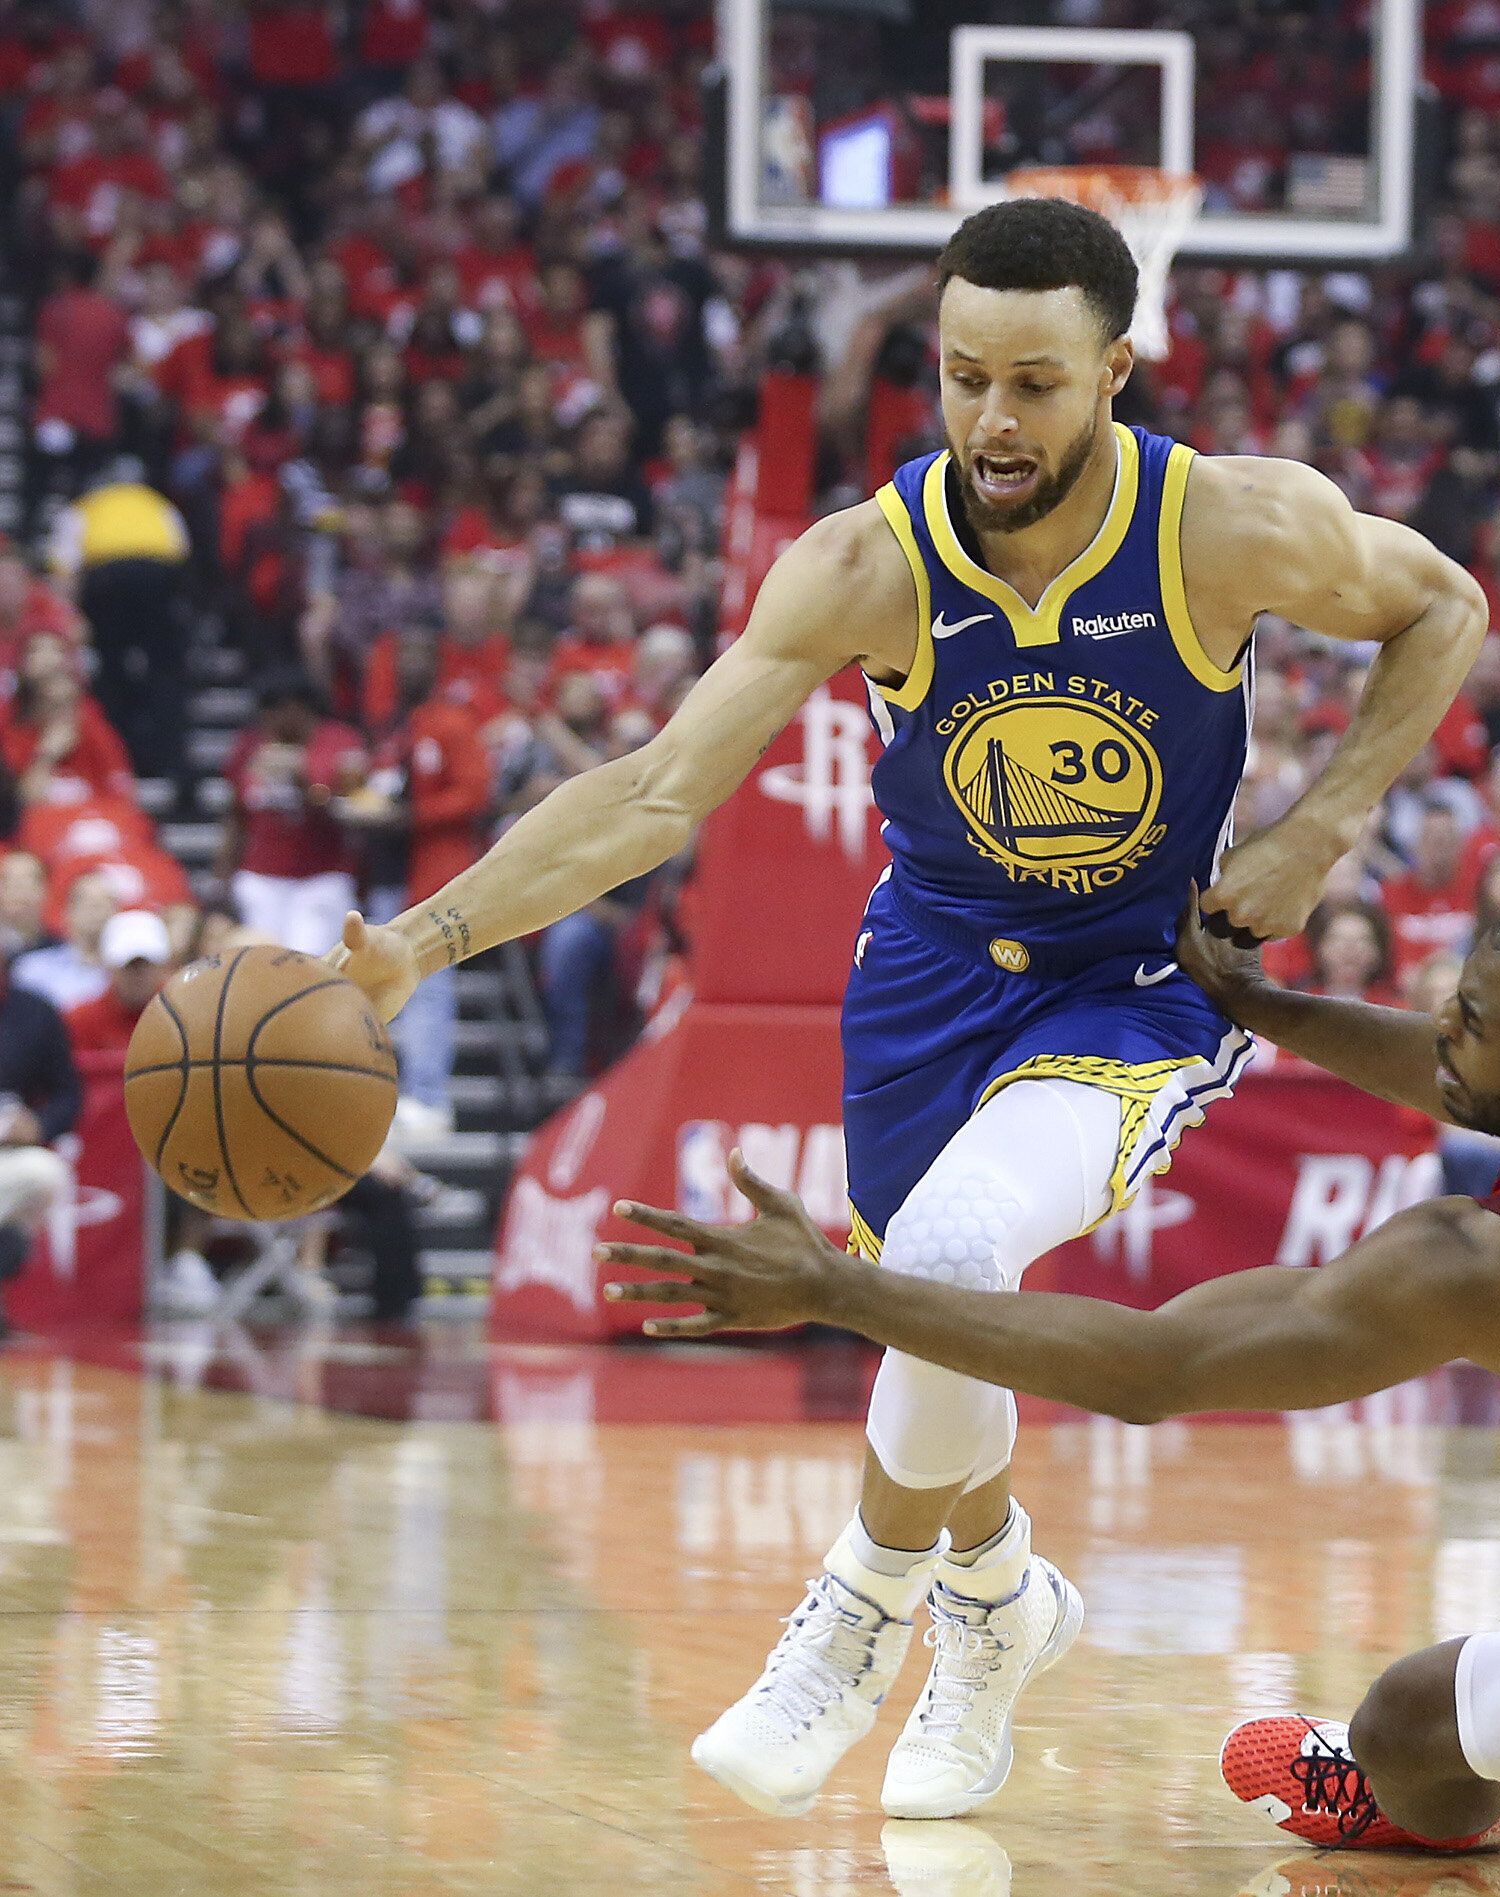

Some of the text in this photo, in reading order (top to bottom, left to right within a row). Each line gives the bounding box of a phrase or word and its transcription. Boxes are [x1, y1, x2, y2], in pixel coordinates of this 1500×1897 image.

[1072, 612, 1156, 639] Rakuten
[935, 672, 1160, 735] GOLDEN STATE
[1049, 739, 1130, 785] 30
[966, 823, 1167, 894] WARRIORS
[993, 945, 1024, 966] W
